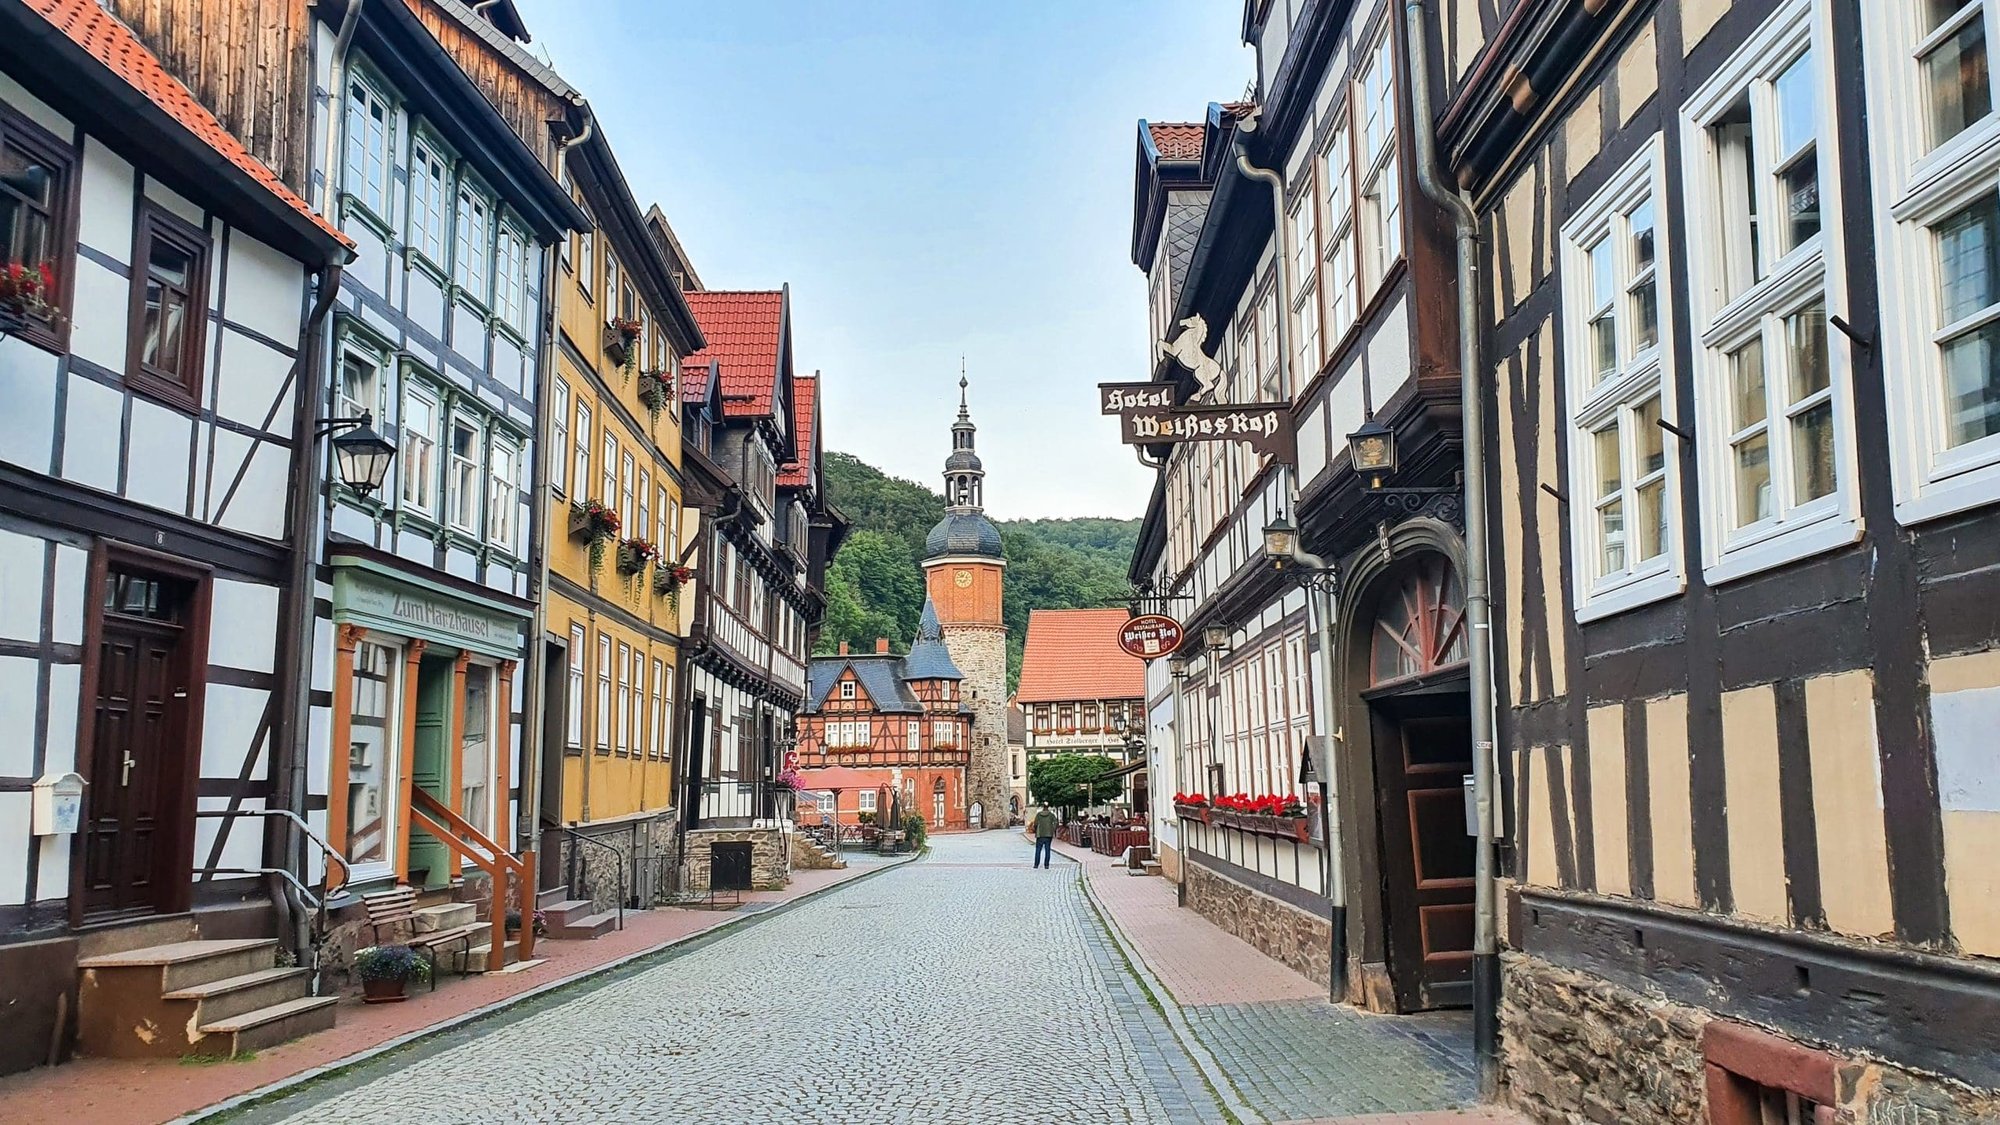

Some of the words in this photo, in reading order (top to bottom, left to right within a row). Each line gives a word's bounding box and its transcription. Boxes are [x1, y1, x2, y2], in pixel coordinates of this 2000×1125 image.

[1105, 388, 1171, 411] Hotel
[157, 533, 163, 544] 8
[393, 594, 424, 621] Zum
[1134, 623, 1165, 631] RESTAURANT
